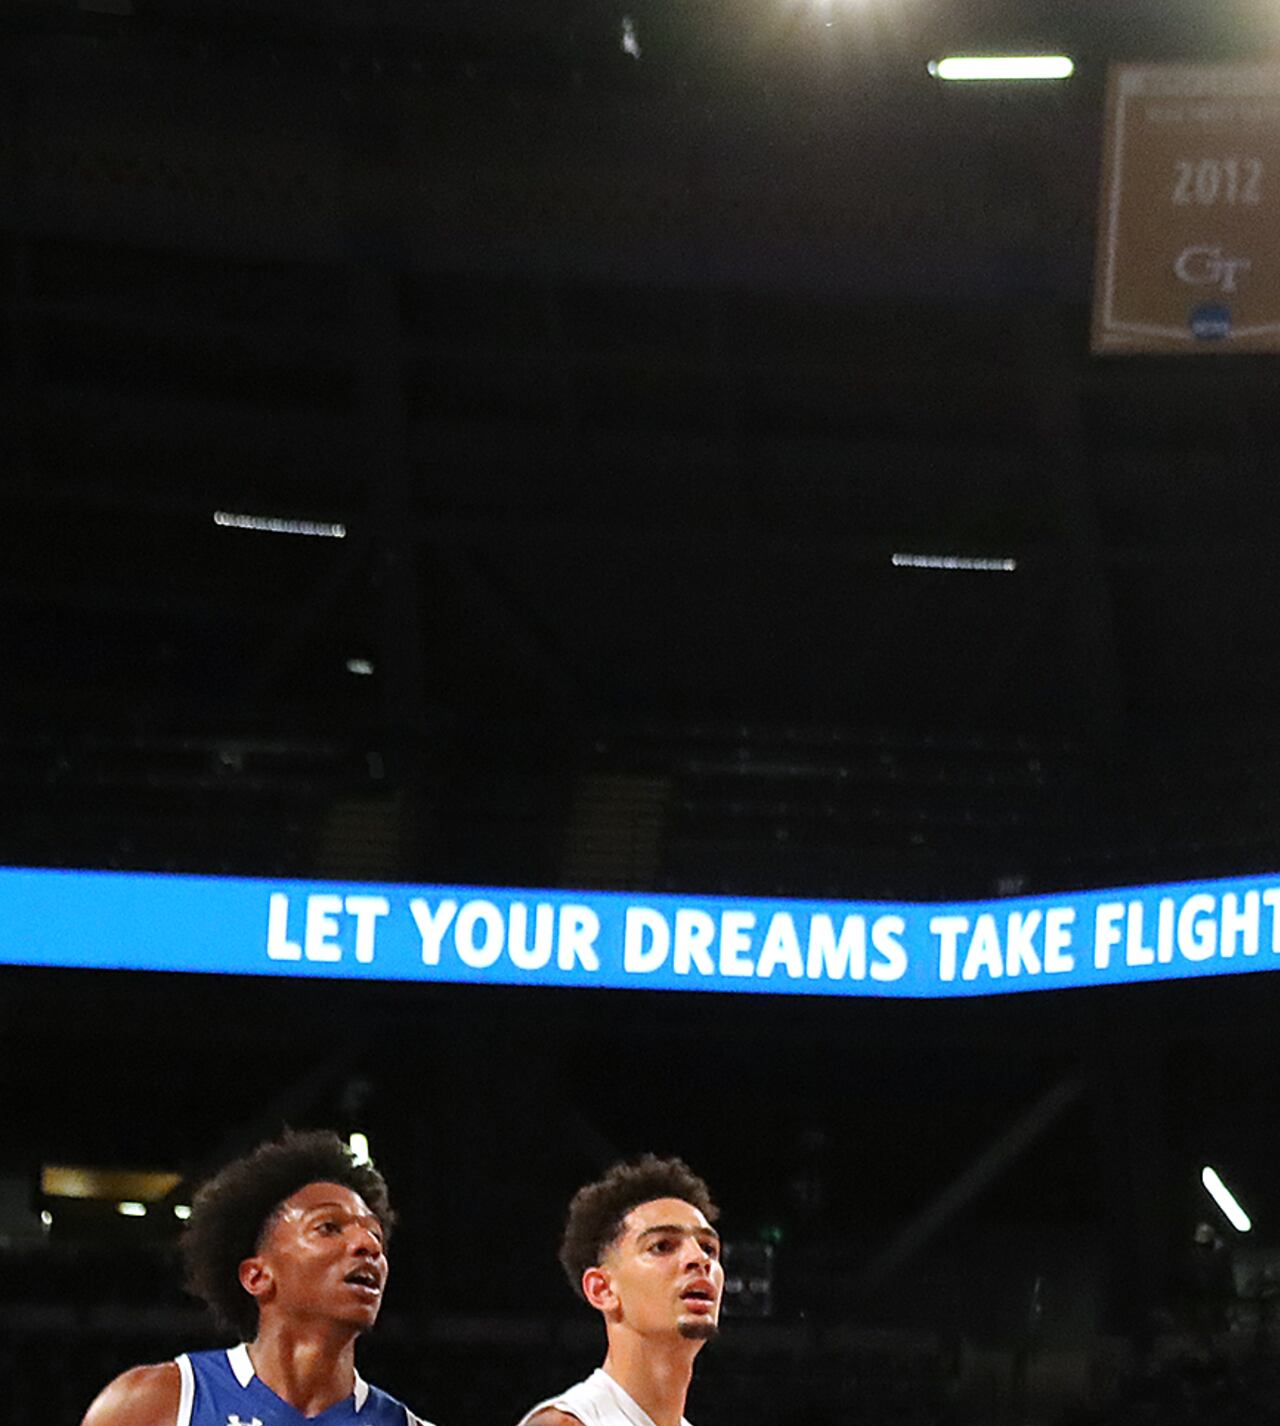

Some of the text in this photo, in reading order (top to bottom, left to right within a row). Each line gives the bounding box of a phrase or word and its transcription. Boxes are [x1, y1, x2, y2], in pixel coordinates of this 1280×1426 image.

[1171, 159, 1263, 205] 2012
[267, 892, 389, 963] LET
[409, 898, 600, 971] YOUR
[624, 906, 908, 982] DREAMS
[930, 906, 1075, 981] TAKE
